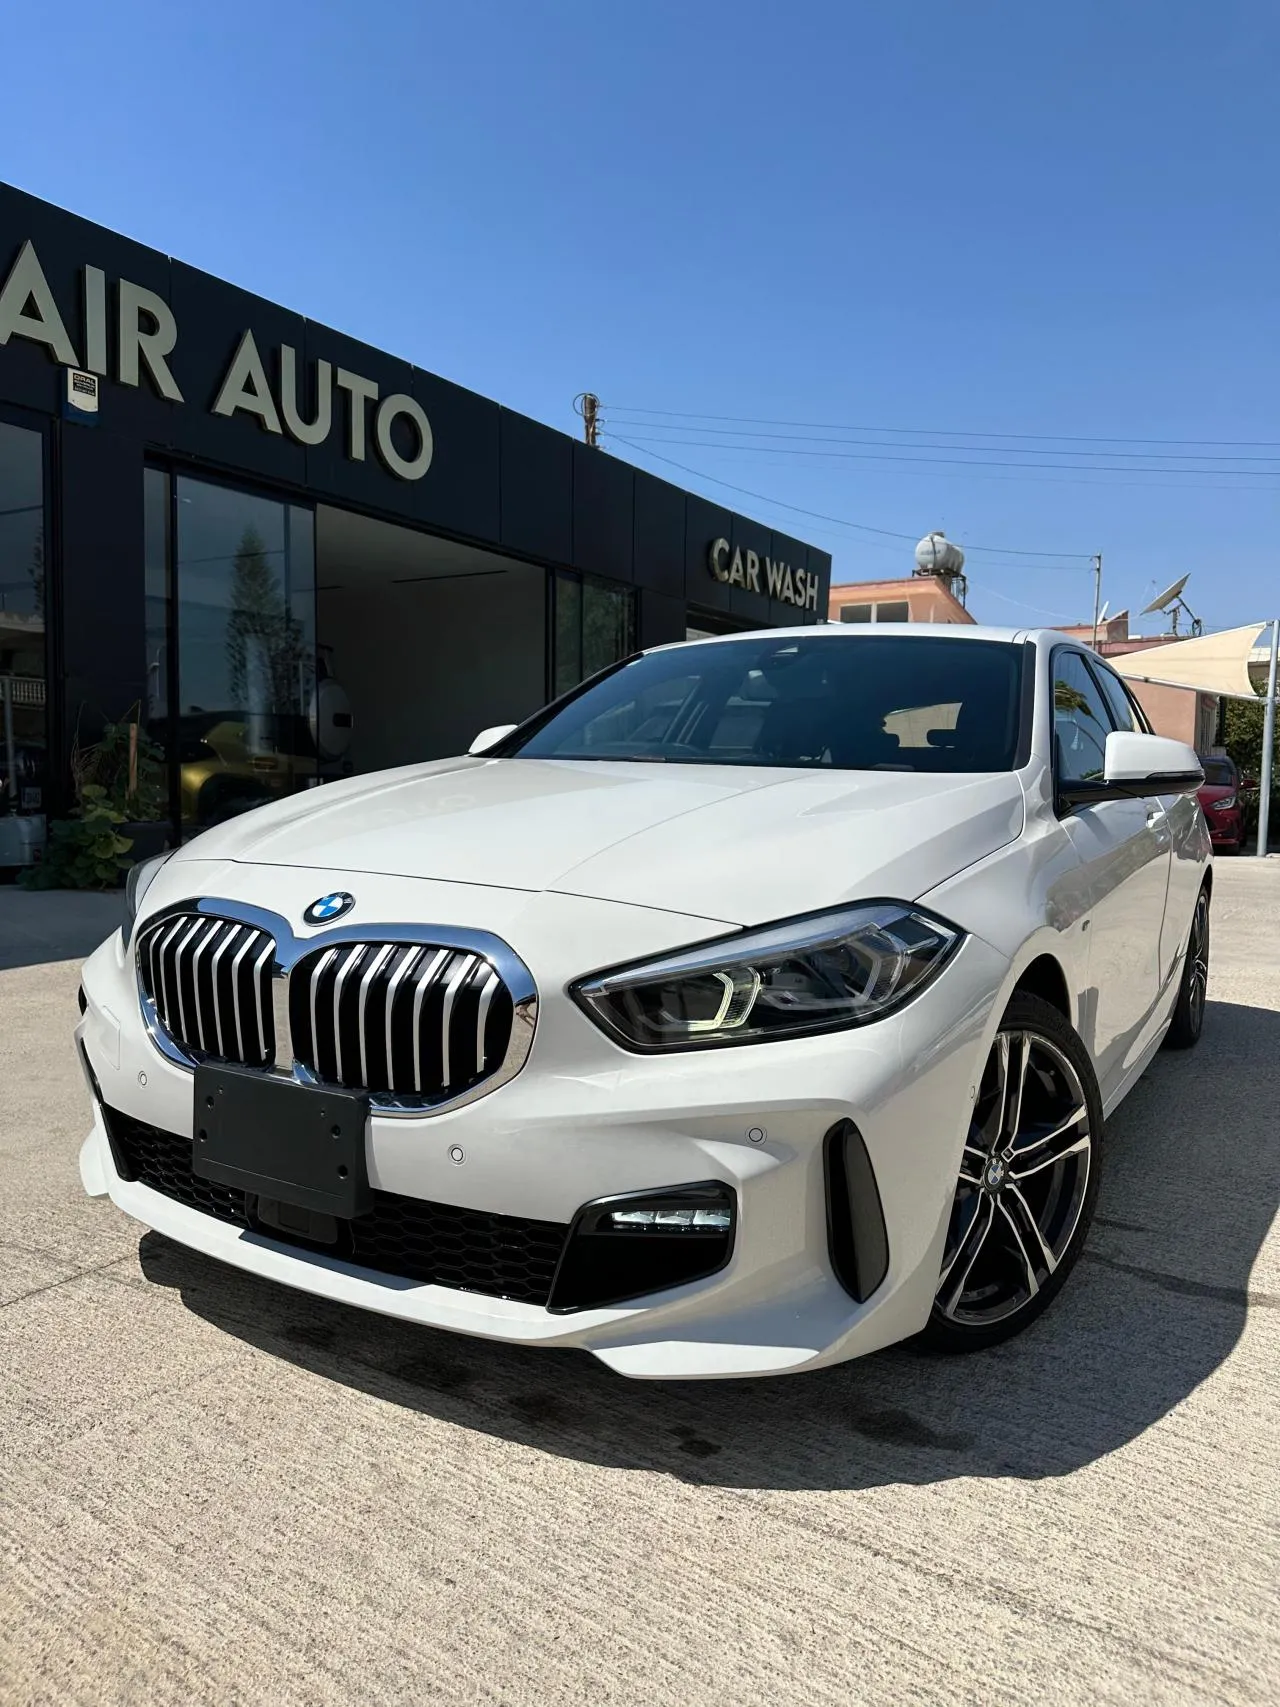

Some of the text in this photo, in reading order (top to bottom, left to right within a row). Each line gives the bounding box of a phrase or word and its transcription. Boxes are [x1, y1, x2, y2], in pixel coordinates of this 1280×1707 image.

[0, 239, 434, 481] AIR AUTO
[710, 537, 819, 611] CAR WASH
